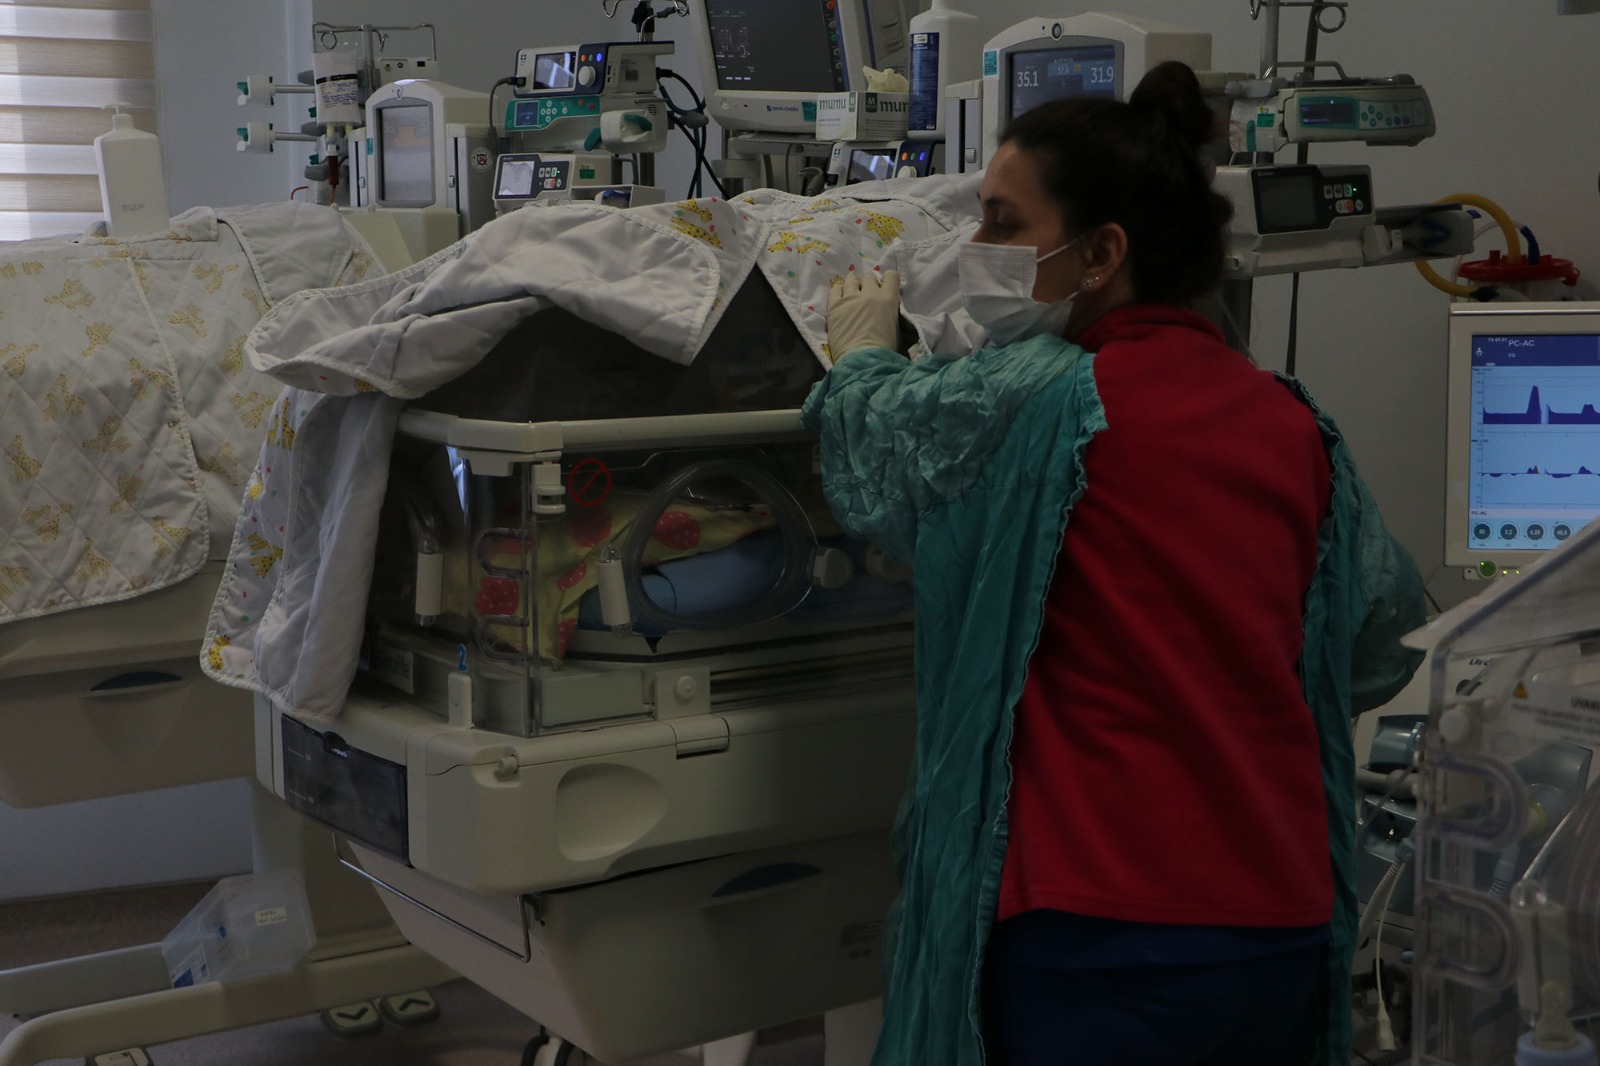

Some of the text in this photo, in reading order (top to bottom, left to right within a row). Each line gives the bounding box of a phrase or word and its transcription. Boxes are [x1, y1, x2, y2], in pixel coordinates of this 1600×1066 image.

[1017, 70, 1039, 87] 35.1
[1091, 66, 1114, 83] 31.9
[819, 98, 846, 110] mumu
[457, 644, 468, 672] 2
